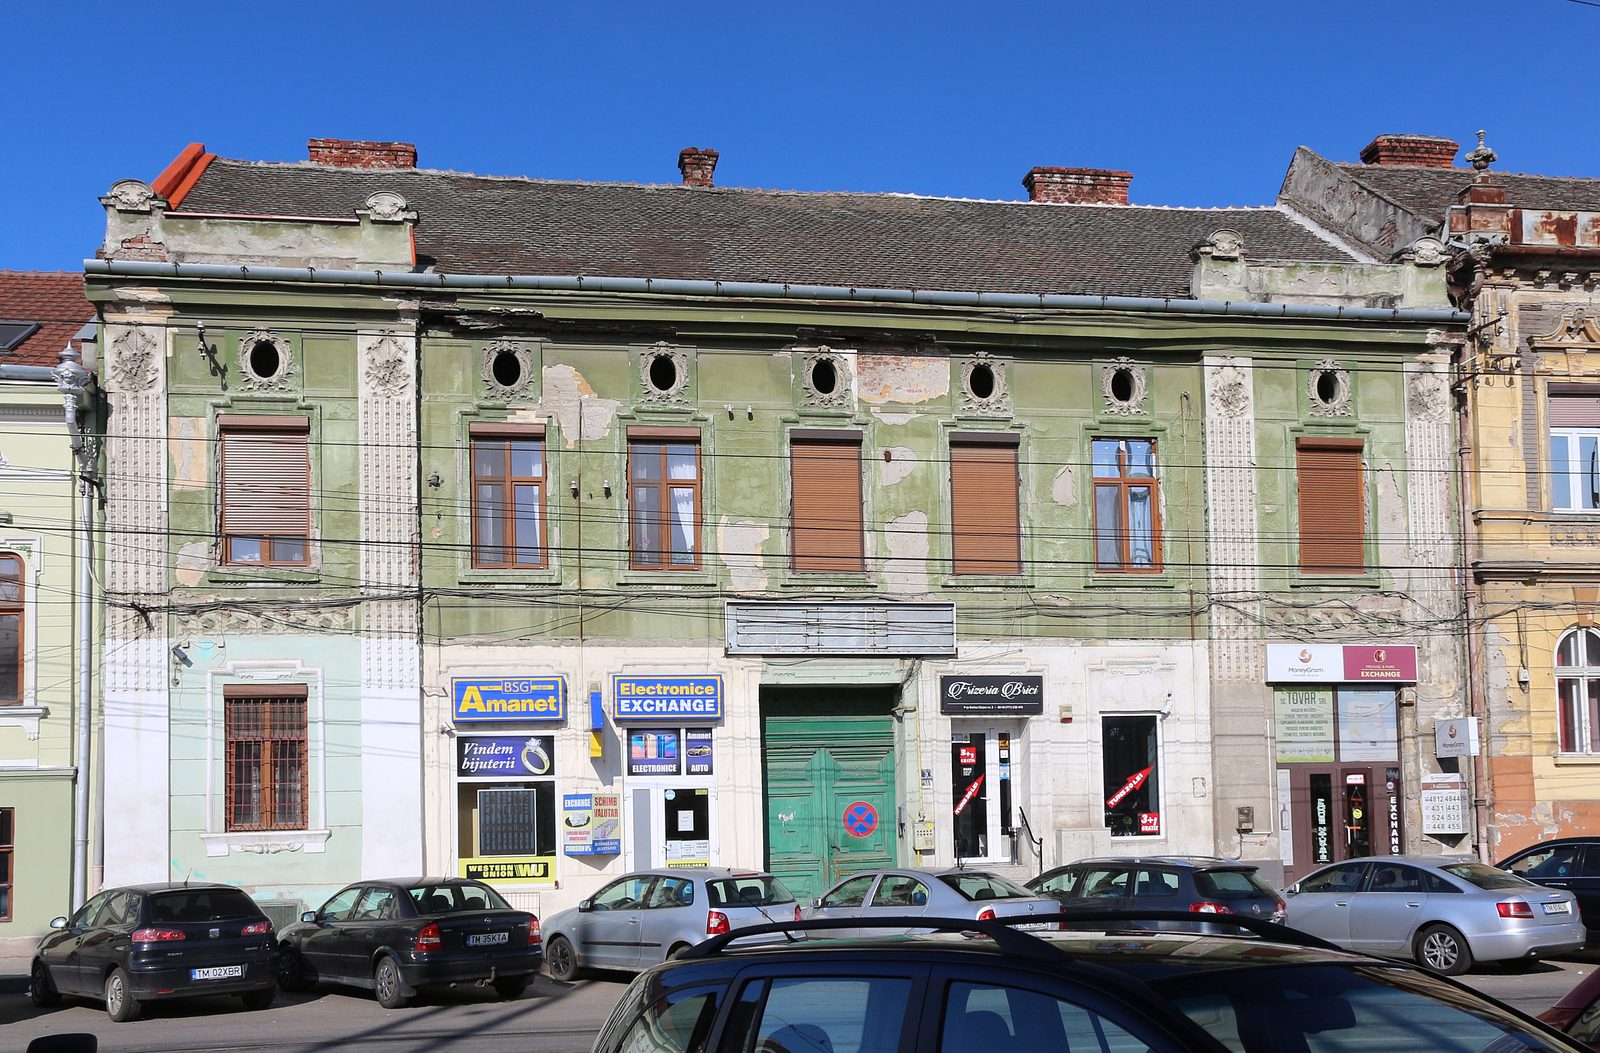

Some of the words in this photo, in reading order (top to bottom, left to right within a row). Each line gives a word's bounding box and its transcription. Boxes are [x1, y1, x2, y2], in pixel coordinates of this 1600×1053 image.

[504, 682, 529, 693] BSG
[620, 683, 715, 695] Electronice
[947, 681, 999, 700] Frizeria
[1001, 681, 1040, 700] Brici
[458, 685, 557, 712] Amanet
[1288, 691, 1316, 705] TOVAR
[620, 699, 716, 712] EXCHANGE
[687, 732, 711, 740] Amanet
[463, 743, 514, 755] Vindem
[461, 757, 516, 772] bijuterii
[632, 764, 677, 773] ELECTRONICE
[690, 764, 709, 772] AUTO
[1108, 789, 1127, 806] TUNS
[1132, 772, 1144, 785] LEI
[564, 798, 591, 808] EXCHANGE
[595, 797, 618, 806] SCHIMB
[593, 808, 619, 818] VALUTAR
[1140, 814, 1158, 826] 3+1
[1390, 796, 1400, 856] EXCHANG
[468, 864, 514, 873] WESTERN
[483, 870, 514, 878] UNION
[514, 863, 545, 877] WU
[472, 936, 481, 944] TM
[197, 969, 210, 978] TM
[212, 967, 240, 977] 02XBR
